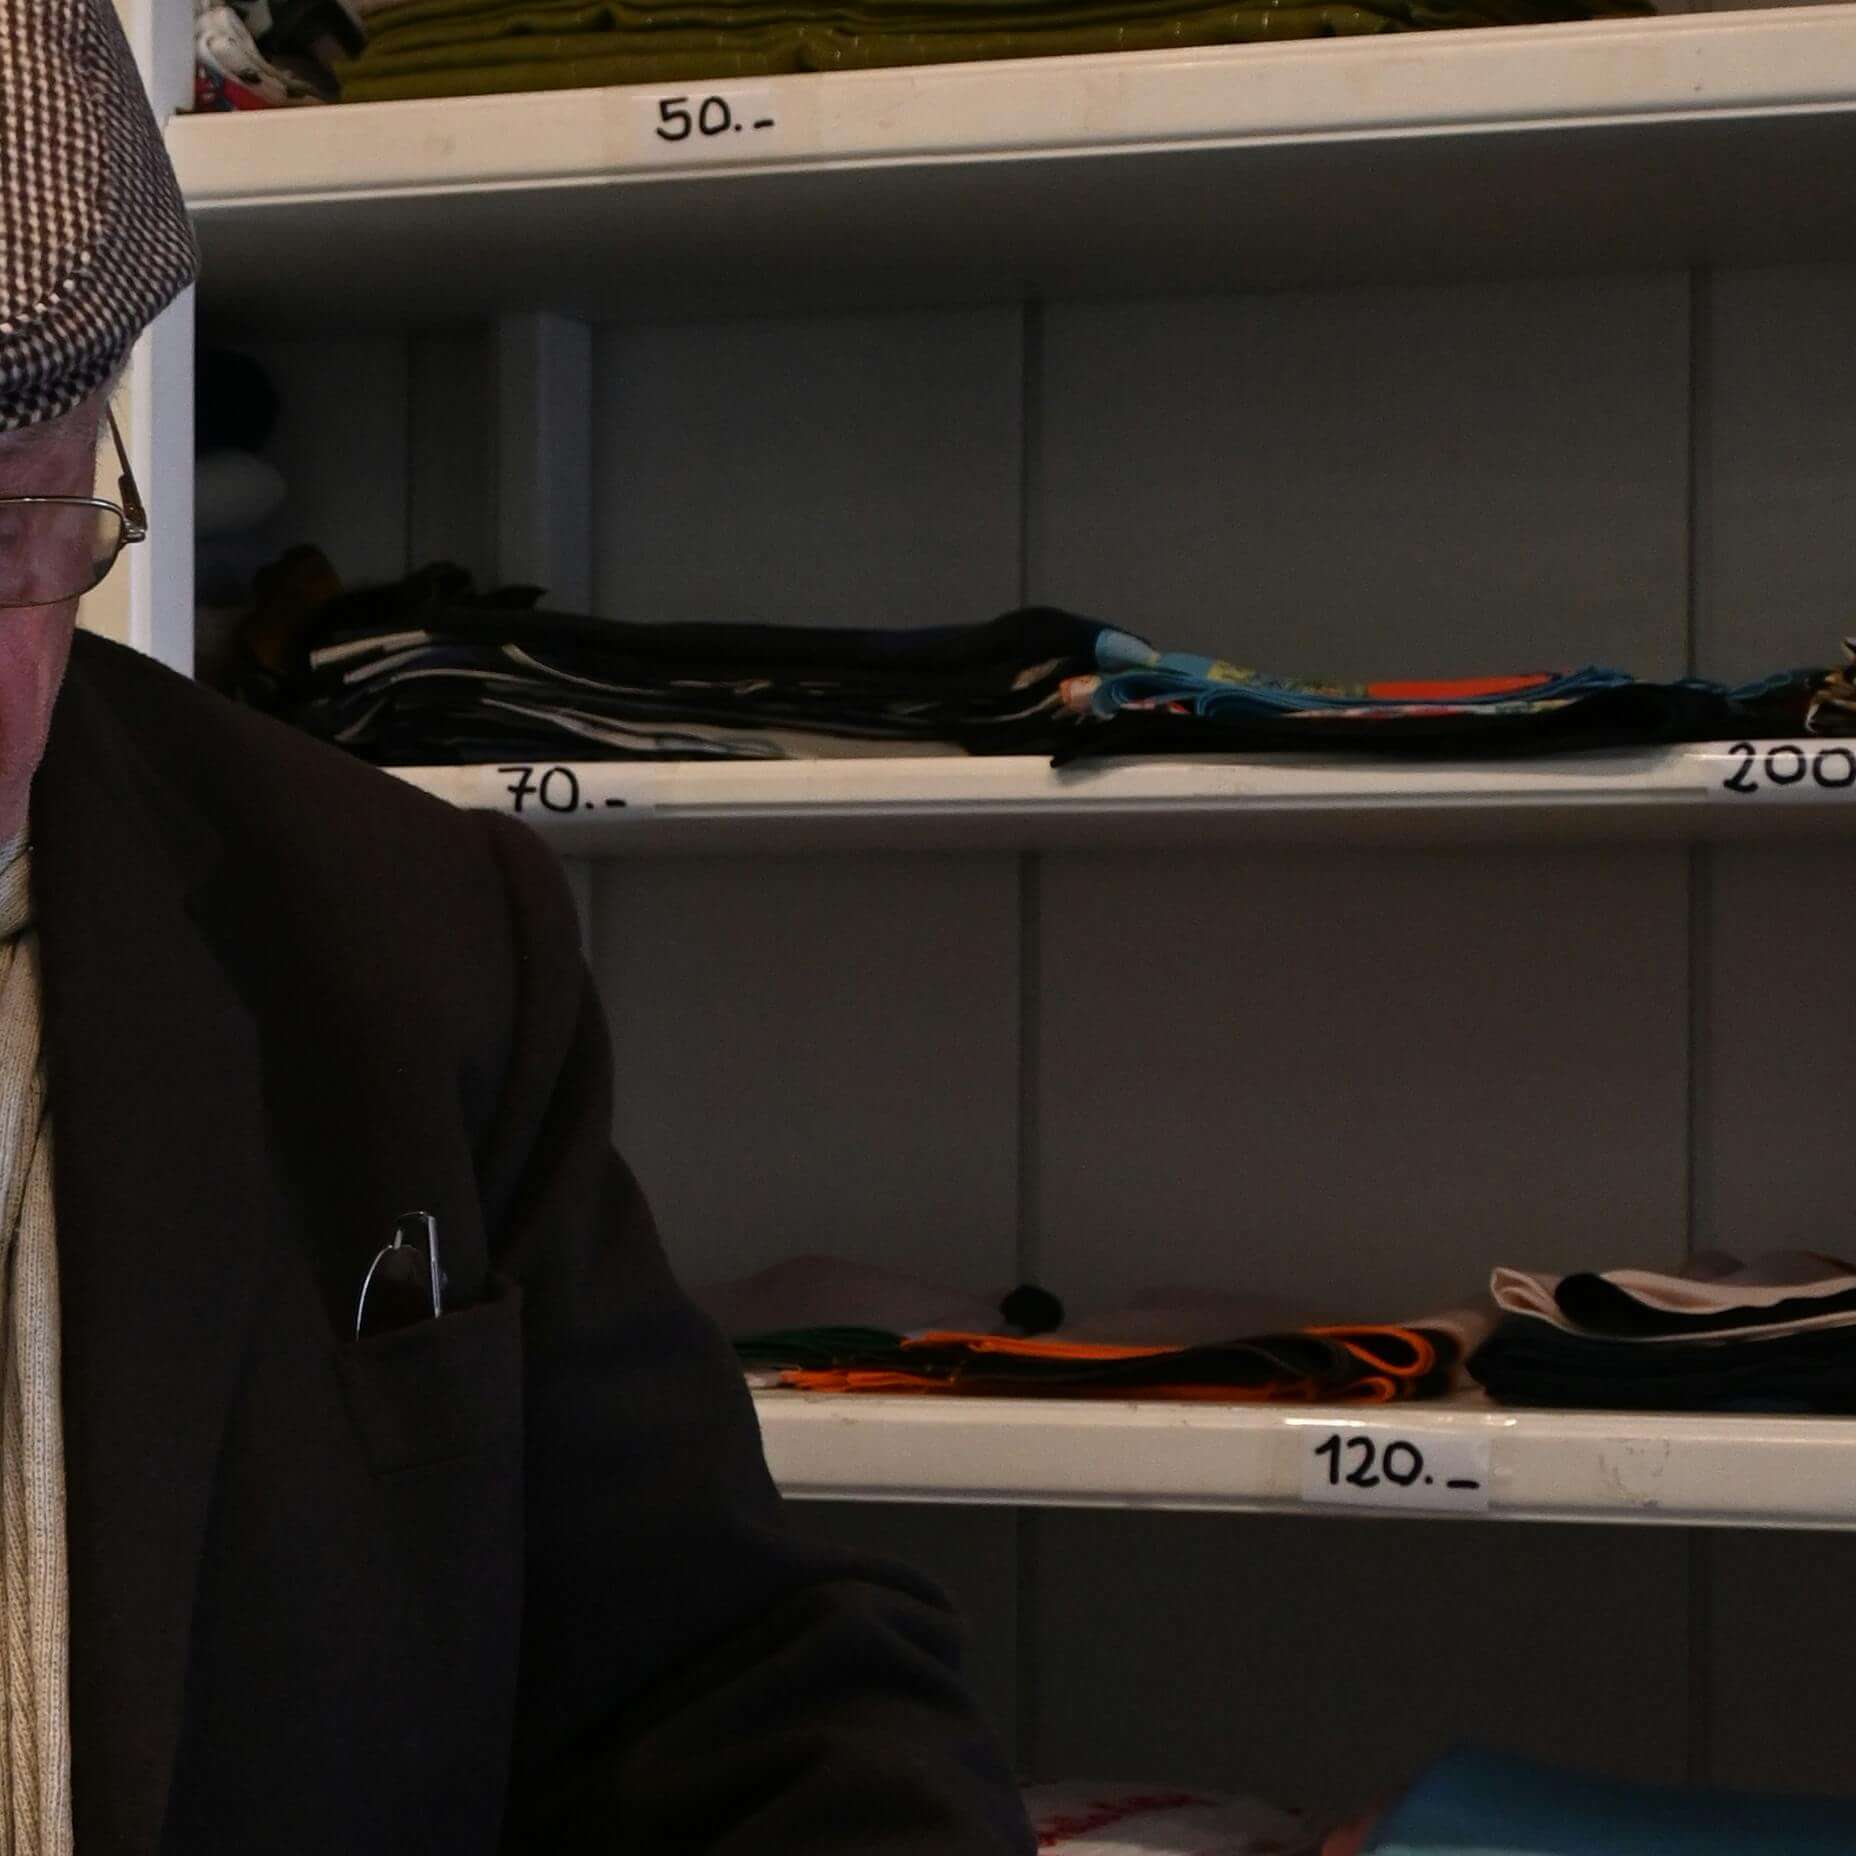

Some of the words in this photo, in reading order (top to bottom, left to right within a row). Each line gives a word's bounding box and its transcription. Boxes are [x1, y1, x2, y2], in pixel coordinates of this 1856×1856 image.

[656, 96, 775, 141] 50.-
[498, 767, 627, 812] 70.-
[1723, 742, 1856, 793] 200
